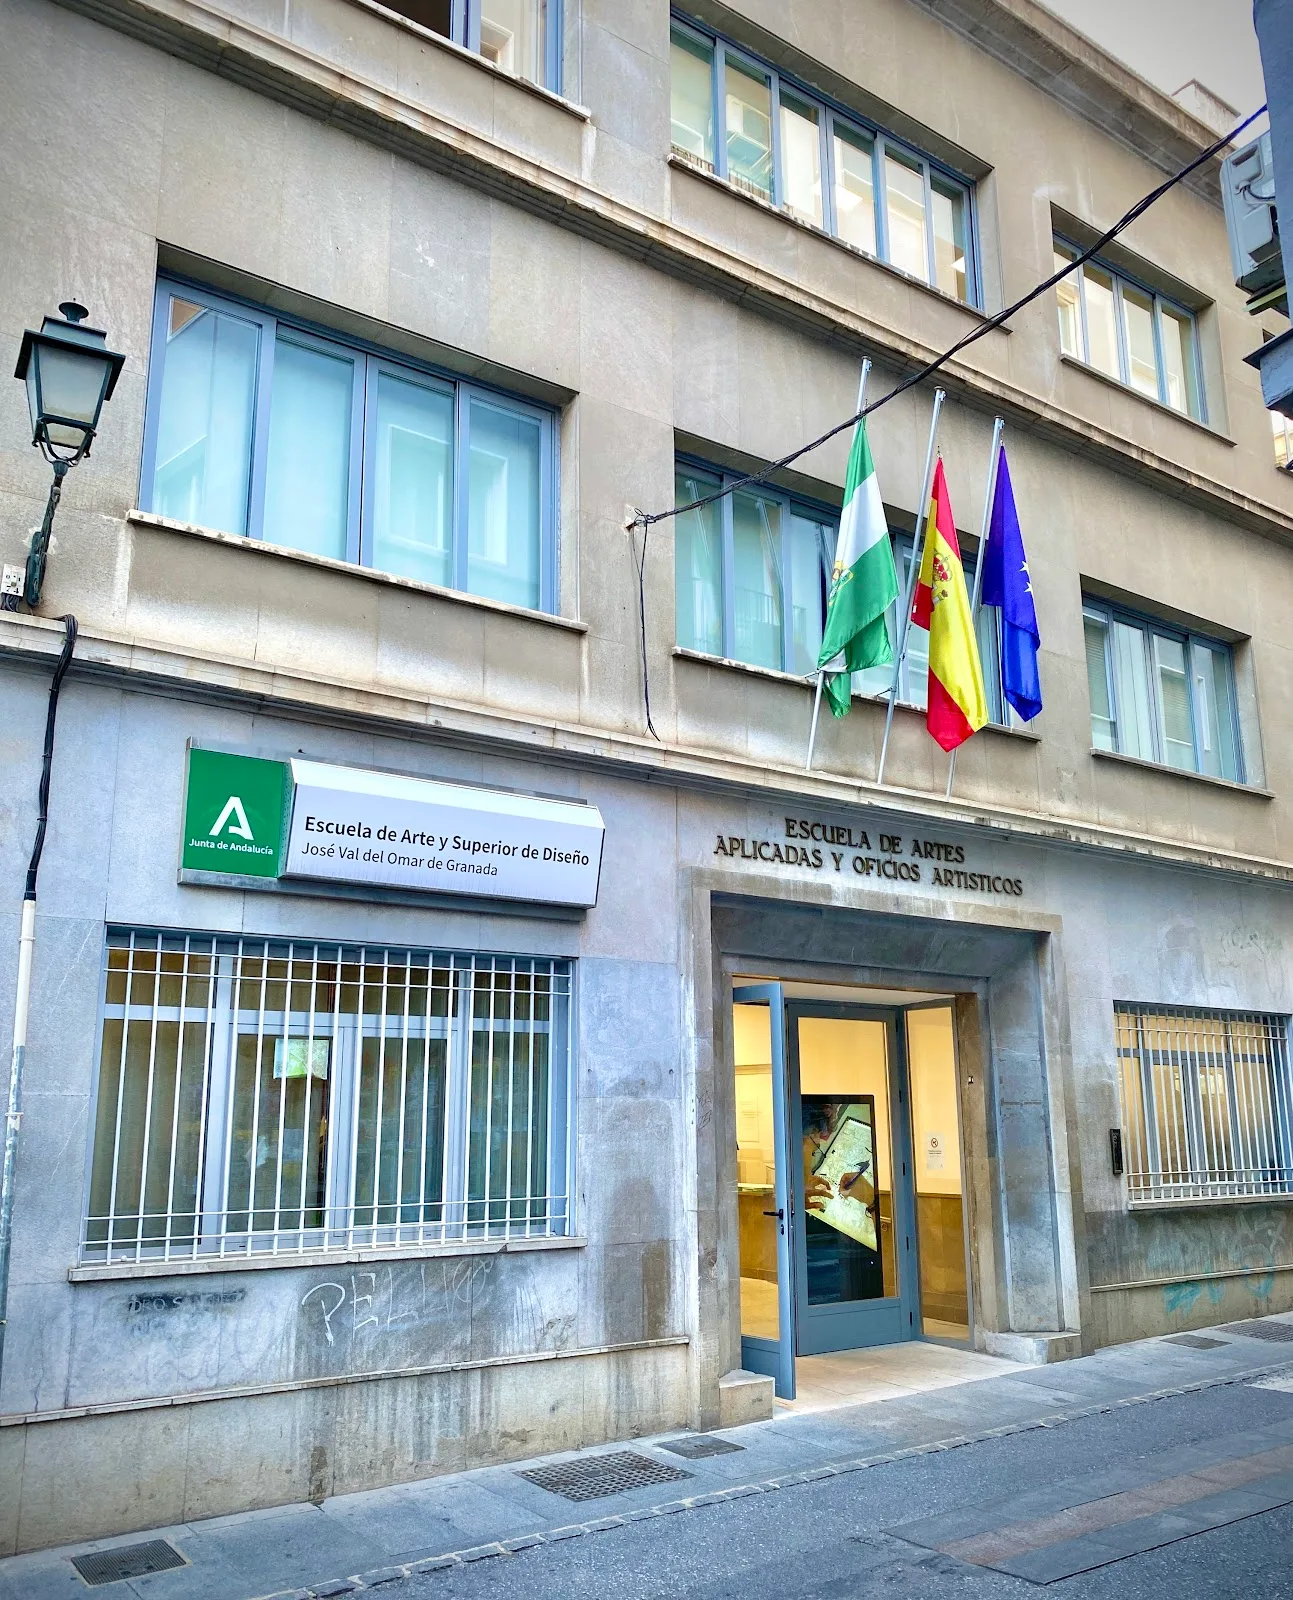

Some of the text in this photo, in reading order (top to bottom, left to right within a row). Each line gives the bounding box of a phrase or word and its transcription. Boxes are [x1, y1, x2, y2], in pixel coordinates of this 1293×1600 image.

[189, 838, 273, 855] Junta de Andalucía
[301, 842, 498, 876] José Val del Omar de Granada
[305, 816, 589, 866] Escuela de Arte y Superior de Diseño
[785, 817, 965, 864] ESCUELA DE ARTES
[713, 835, 1024, 896] APLICADAS Y OFICIOS ARTISTICOS
